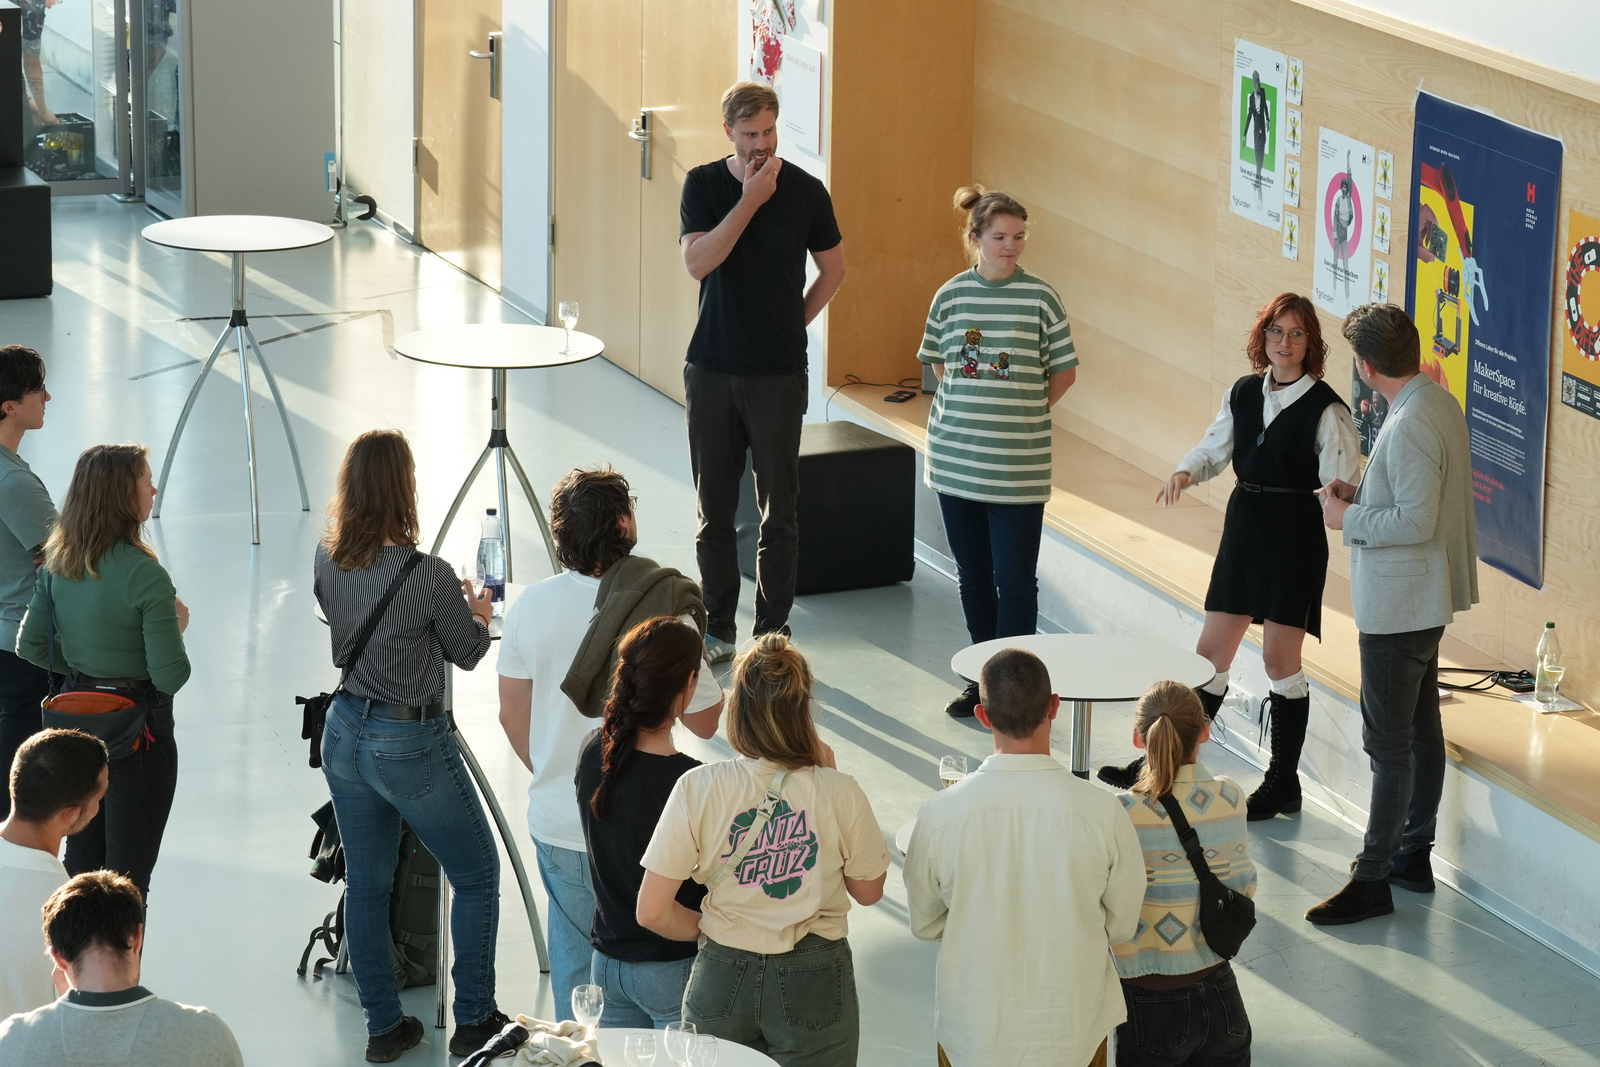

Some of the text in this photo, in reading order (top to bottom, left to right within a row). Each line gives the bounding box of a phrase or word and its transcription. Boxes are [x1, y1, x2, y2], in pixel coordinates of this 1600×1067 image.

[1275, 62, 1280, 72] H
[1361, 154, 1367, 164] H
[1527, 182, 1536, 204] H
[1568, 247, 1585, 288] THE
[1473, 359, 1516, 390] MakerSpace
[1473, 380, 1527, 416] für kreative Köpfe.
[1490, 477, 1499, 487] dich
[738, 846, 811, 888] CRUZ
